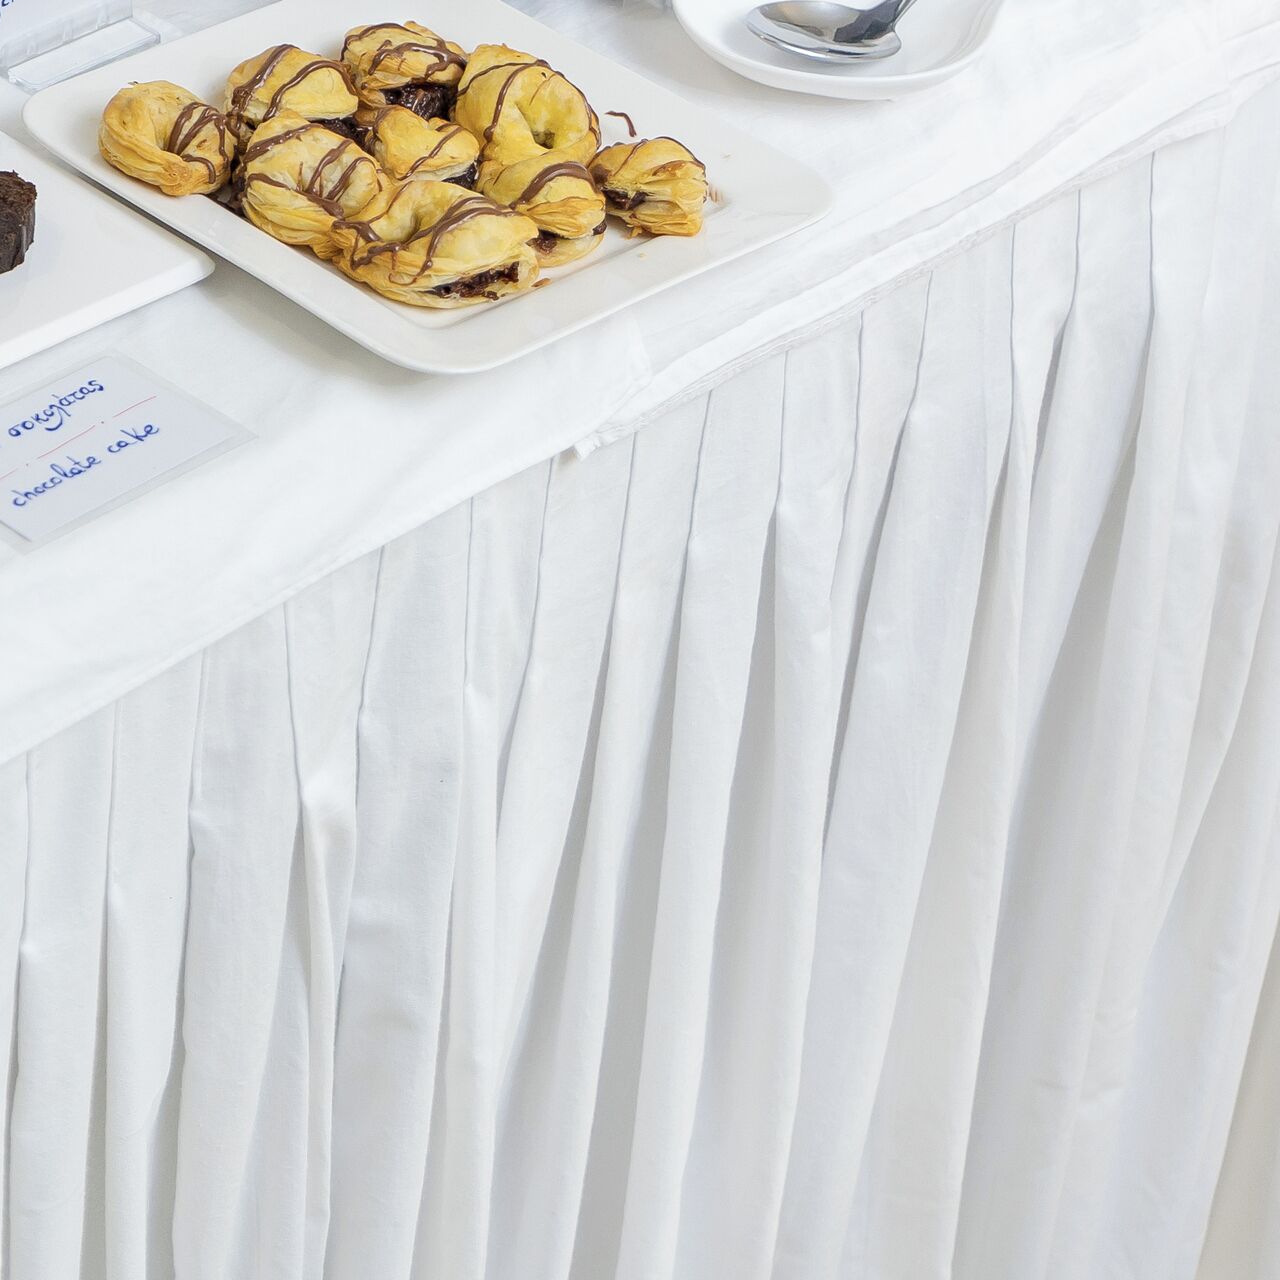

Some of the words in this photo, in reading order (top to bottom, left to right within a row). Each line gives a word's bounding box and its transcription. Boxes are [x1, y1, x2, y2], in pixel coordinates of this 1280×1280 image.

[8, 379, 105, 437] σοκολάτας
[12, 455, 102, 508] chocolate
[107, 421, 160, 454] cake
